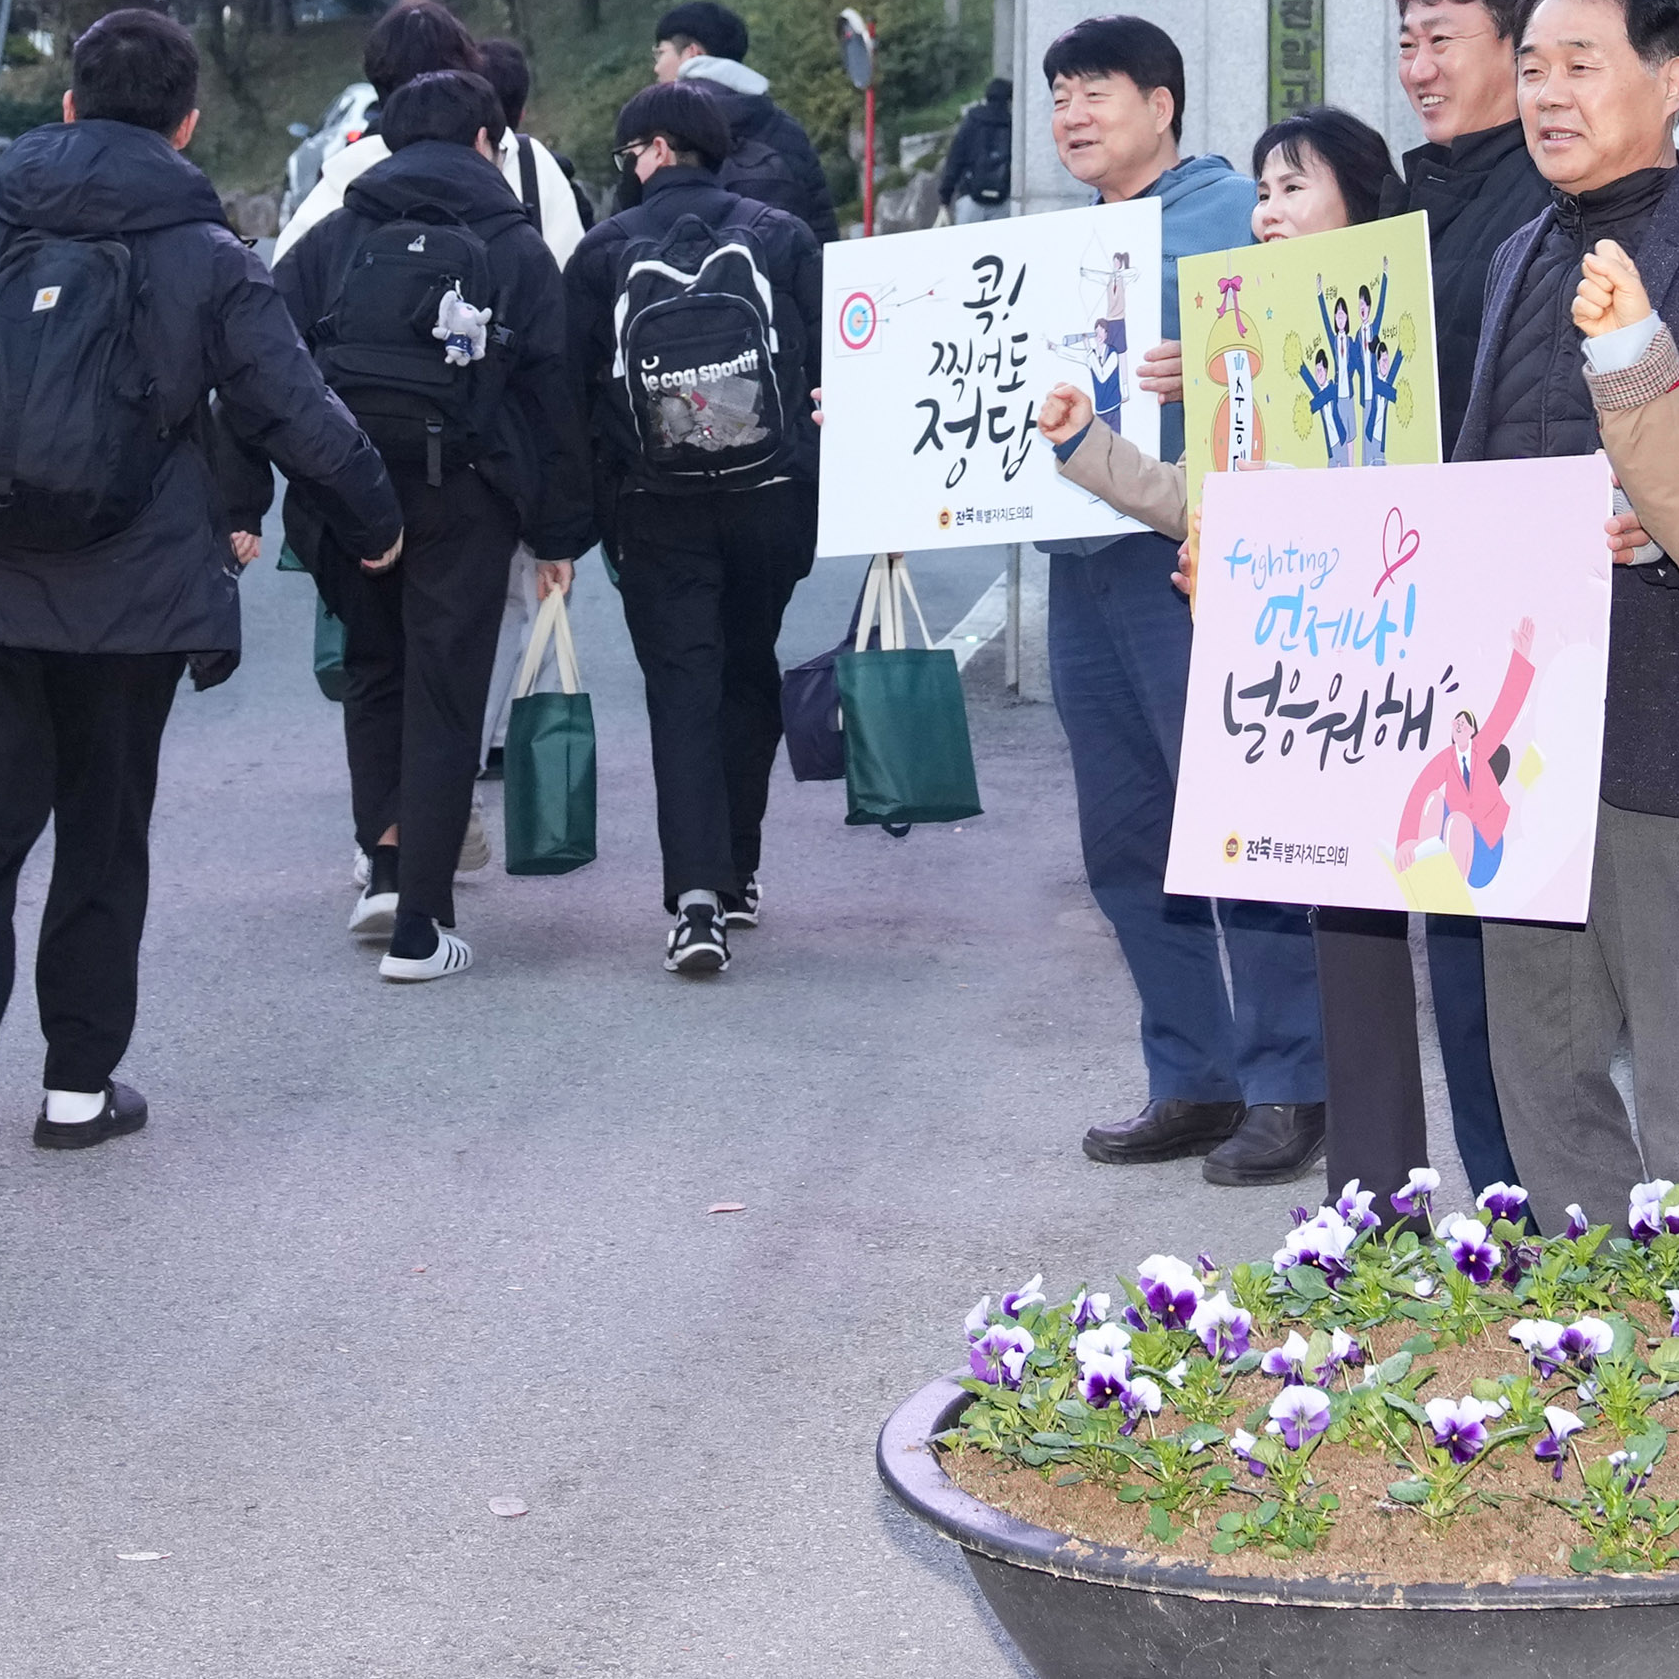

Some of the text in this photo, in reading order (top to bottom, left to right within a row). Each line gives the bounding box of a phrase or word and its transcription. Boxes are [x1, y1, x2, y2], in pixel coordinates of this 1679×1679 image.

[962, 254, 1027, 335] 콕!
[640, 349, 759, 392] le coq sportif
[928, 332, 1029, 403] 찍어도
[913, 386, 1039, 489] 정답
[1223, 537, 1340, 590] fighting
[1254, 583, 1416, 666] 언제나!
[1246, 836, 1349, 866] 전북특별자치도의회
